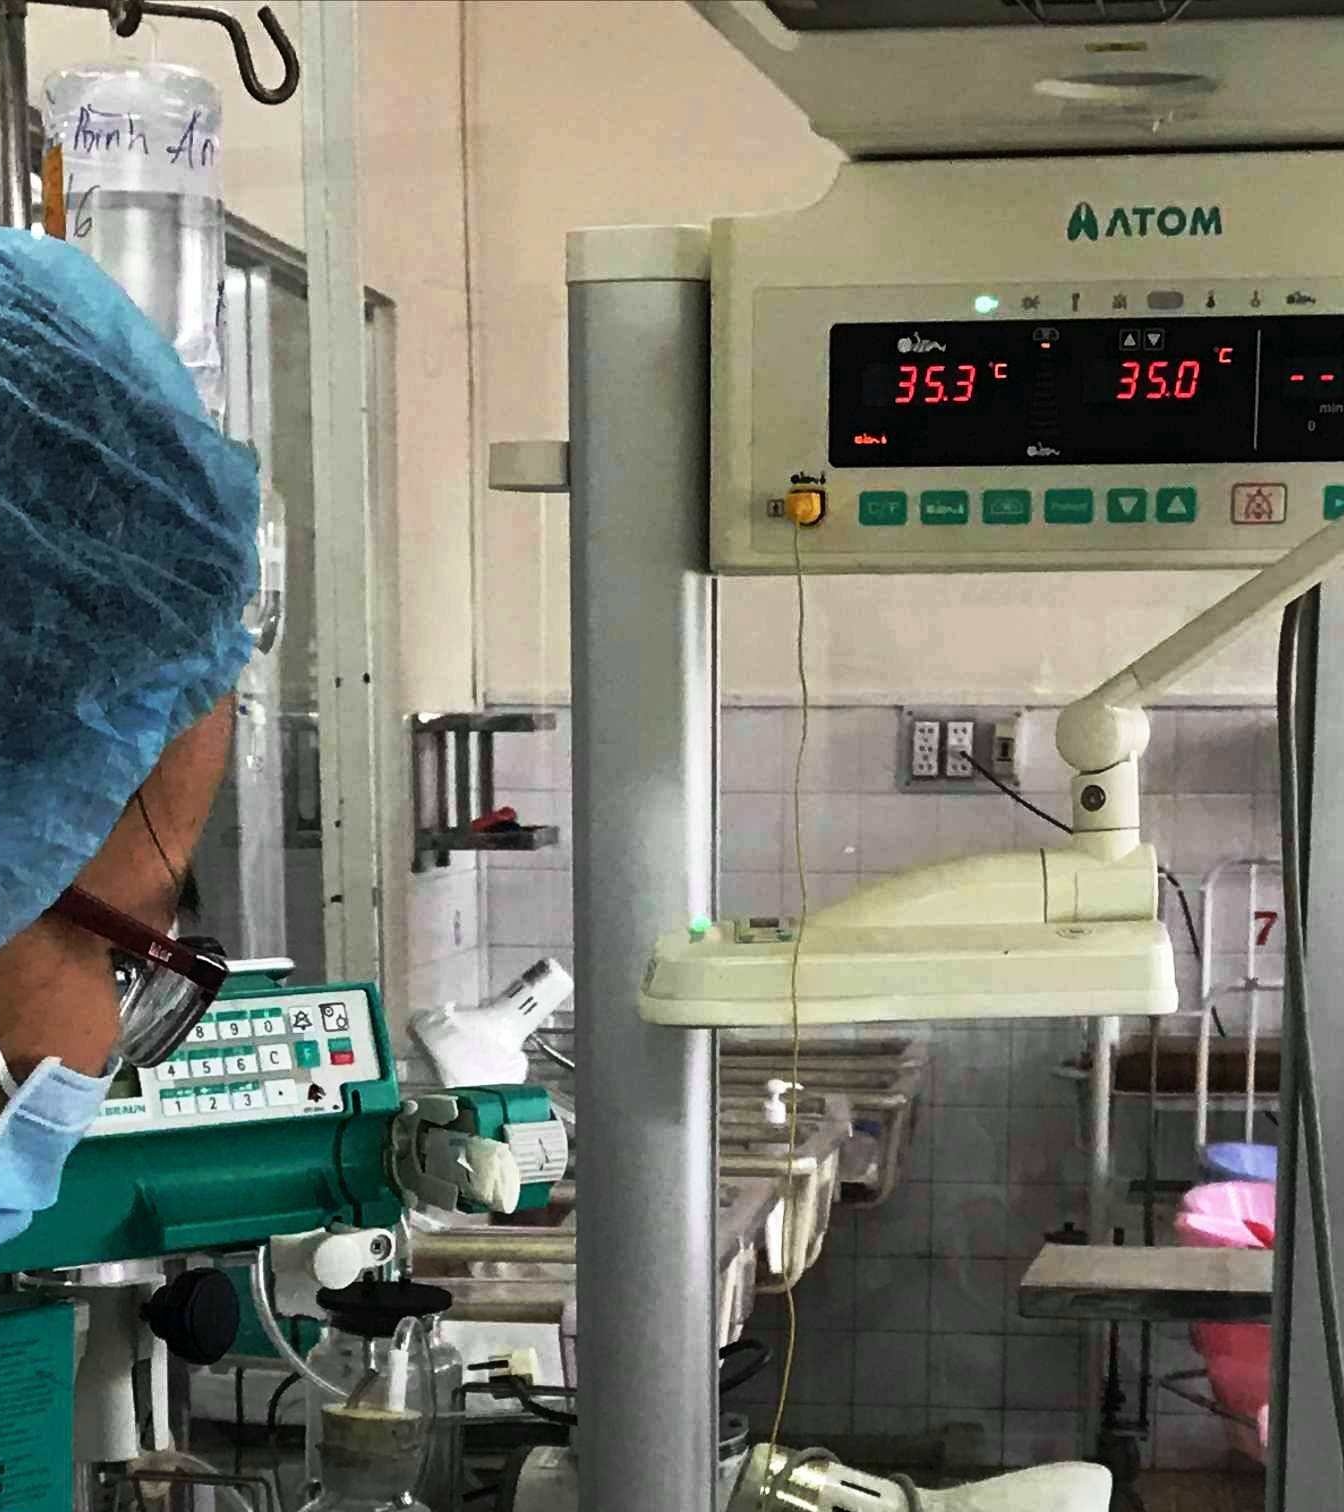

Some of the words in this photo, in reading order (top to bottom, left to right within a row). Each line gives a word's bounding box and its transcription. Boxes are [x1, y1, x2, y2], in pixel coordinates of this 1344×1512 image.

[1106, 206, 1222, 236] ATOM
[895, 365, 976, 403] 35.3
[1116, 360, 1200, 399] 35.0
[1319, 402, 1344, 414] min
[1254, 911, 1278, 946] 7
[195, 1026, 204, 1039] 8
[230, 1023, 239, 1036] 9
[264, 1020, 273, 1034] 0
[167, 1065, 176, 1076] 4
[202, 1062, 212, 1074] 5
[237, 1058, 246, 1071] 6
[270, 1051, 280, 1065] C
[175, 1100, 182, 1112] 1
[209, 1097, 217, 1110] 2
[244, 1094, 252, 1107] 3
